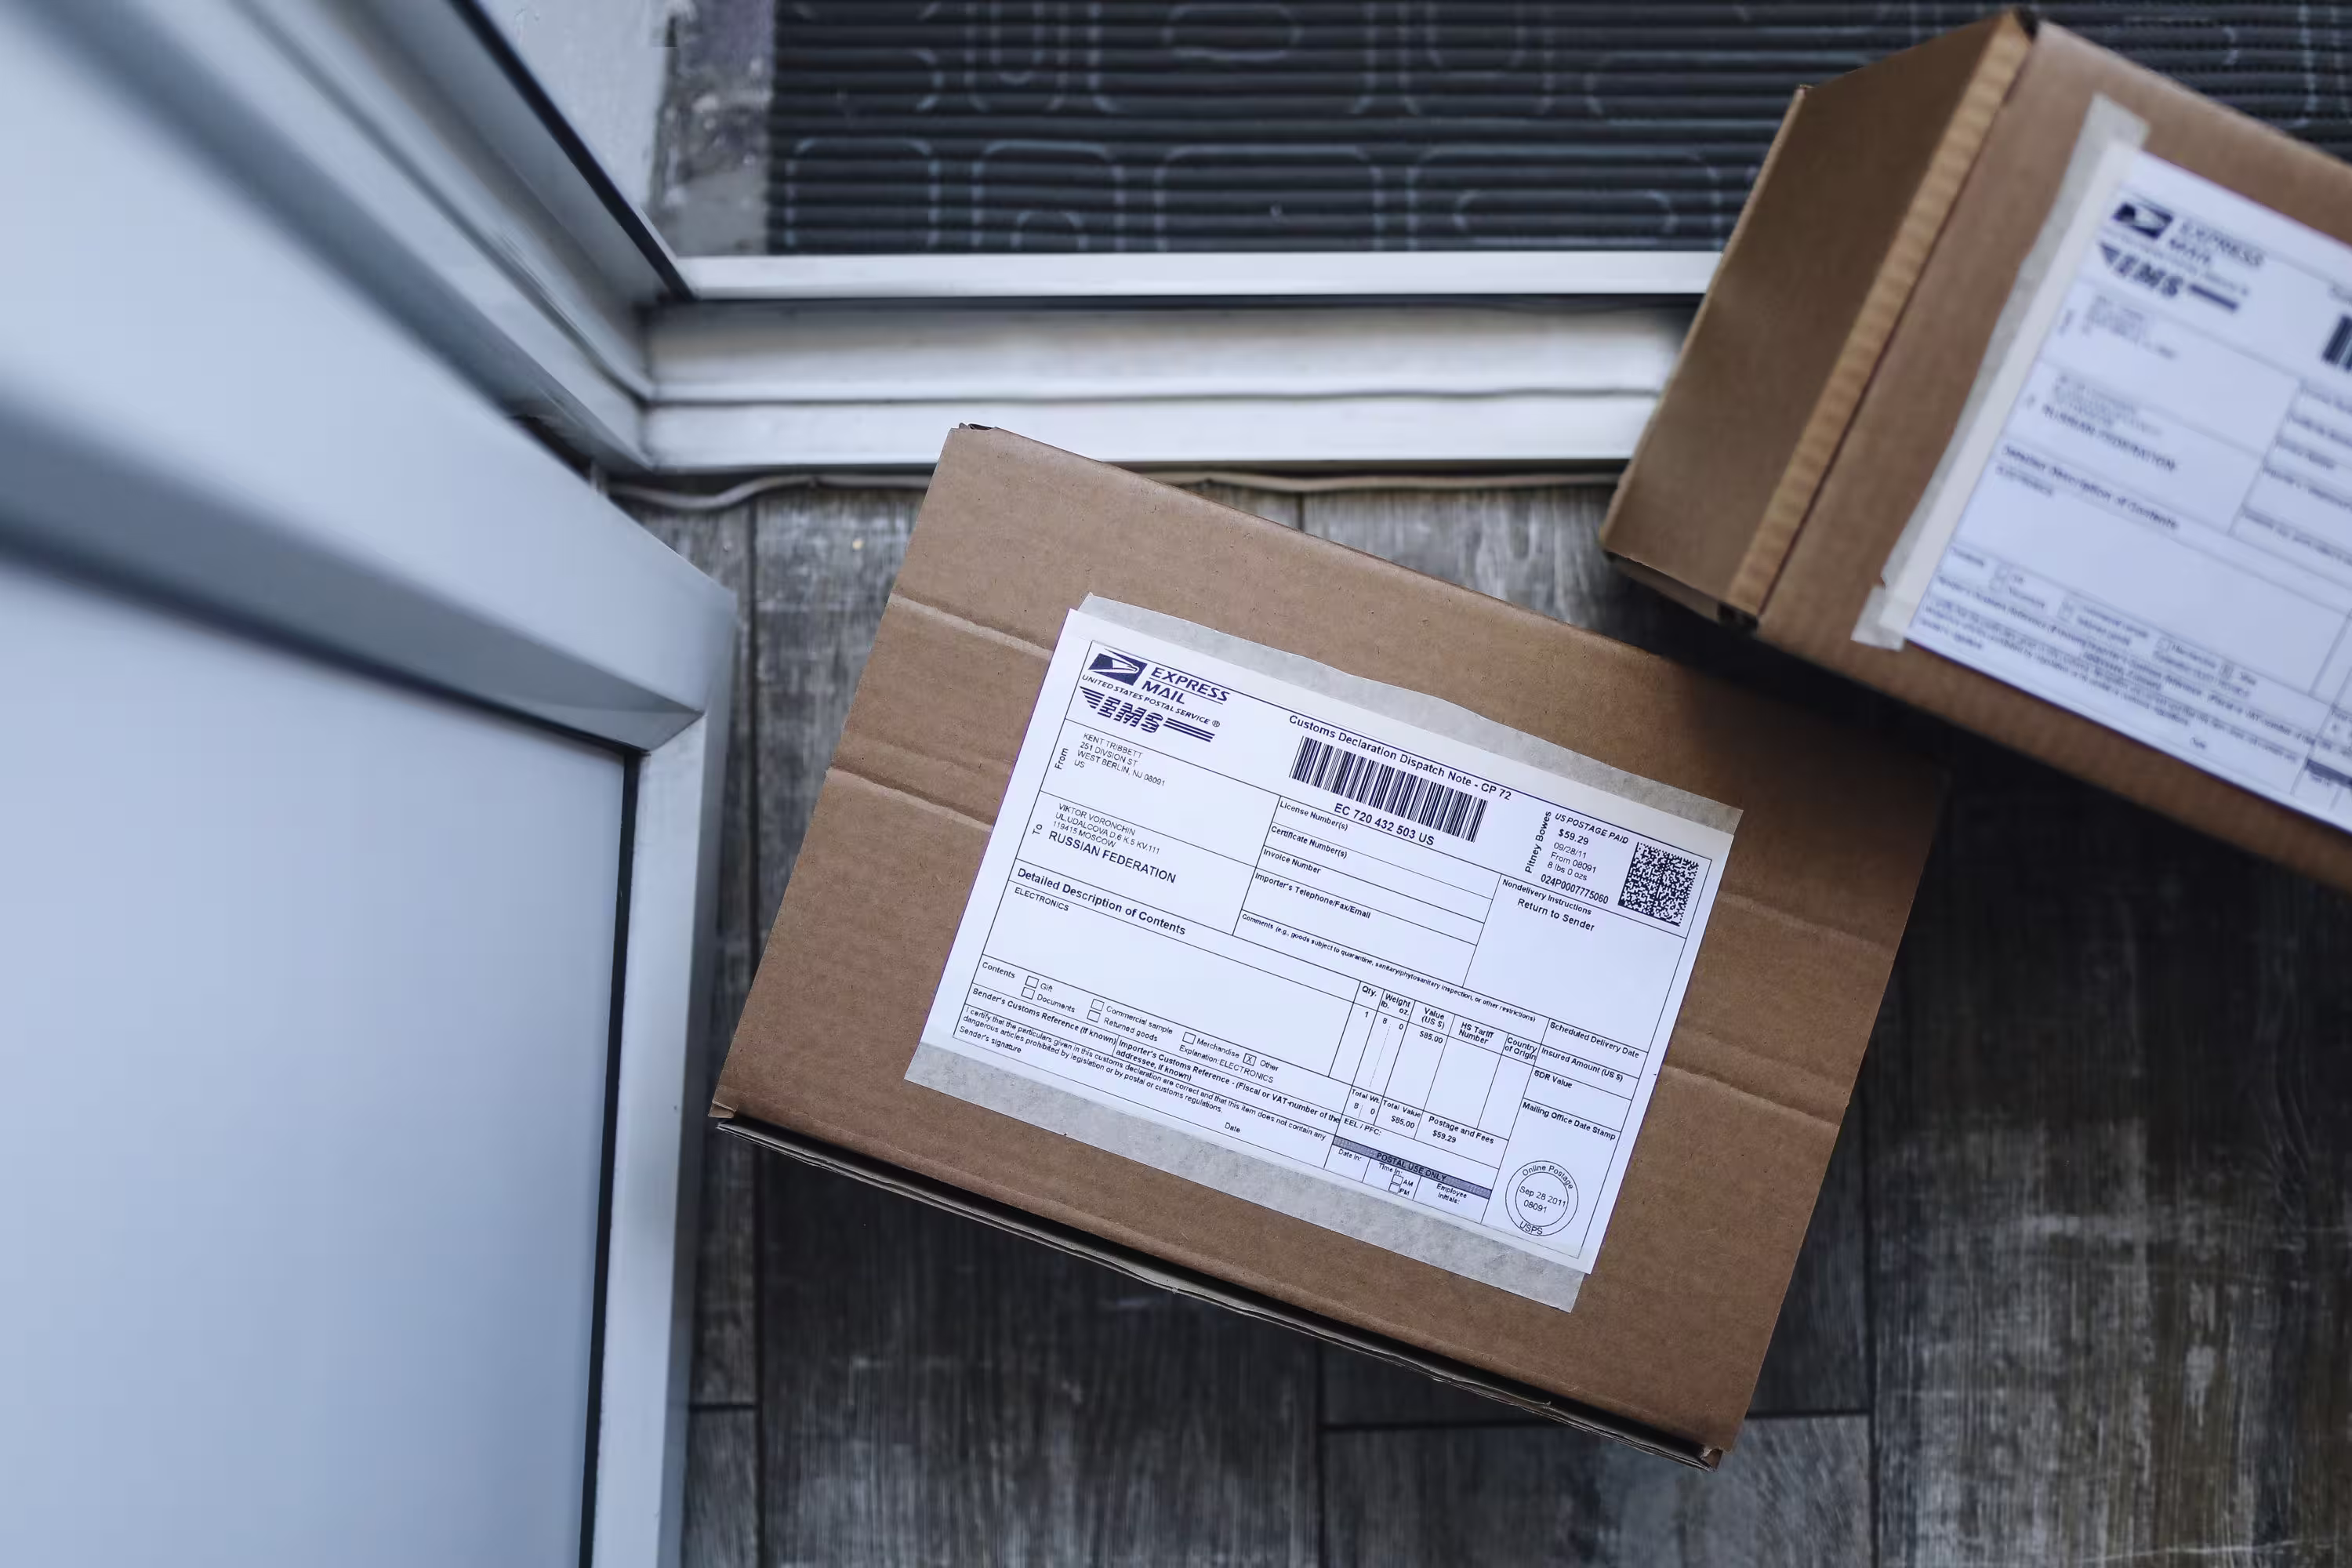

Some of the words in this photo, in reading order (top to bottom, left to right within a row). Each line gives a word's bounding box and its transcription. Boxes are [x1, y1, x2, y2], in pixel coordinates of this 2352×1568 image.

[1141, 680, 1185, 705] MAIL
[1150, 666, 1230, 702] EXPRESS
[1081, 673, 1114, 689] UNITED
[1113, 686, 1143, 700] STATES
[1143, 696, 1174, 712] POSTAL
[1174, 708, 1210, 724] SERVICE
[1096, 695, 1164, 734] EMS
[1079, 741, 1093, 751] 251
[1094, 746, 1127, 764] DIVSION
[1127, 757, 1138, 767] ST
[1083, 732, 1105, 745] KENT
[1106, 740, 1143, 758] TRIBBETT
[1289, 714, 1336, 739] Customs
[1338, 731, 1397, 760] Declaration
[1399, 753, 1445, 777] Dispatch
[1446, 770, 1472, 786] Note
[1480, 782, 1497, 794] CP
[1498, 788, 1512, 800] 72
[1054, 747, 1069, 770] From
[1073, 759, 1085, 768] US
[1077, 749, 1102, 763] WEST
[1101, 757, 1130, 775] BERLIN,
[1132, 769, 1143, 779] NJ
[1143, 773, 1165, 786] 08091
[1031, 823, 1043, 835] To
[1058, 803, 1087, 819] VIKTOR
[1088, 813, 1136, 836] VORONCHIN
[1279, 800, 1309, 817] License
[1309, 811, 1348, 832] Number(s)
[1334, 802, 1351, 816] EC
[1353, 808, 1373, 824] 720
[1374, 817, 1395, 832] 432
[1396, 824, 1416, 840] 503
[1418, 832, 1435, 846] US
[1555, 812, 1566, 822] US
[1566, 816, 1608, 837] POSTAGE
[1607, 831, 1629, 844] PAID
[1053, 820, 1078, 834] 119415
[1077, 829, 1116, 848] MOSCOW
[1270, 826, 1308, 844] Certificate
[1308, 838, 1348, 859] Number(s)
[1524, 843, 1542, 873] Pitney
[1534, 811, 1552, 842] Bowes
[1558, 828, 1589, 846] $59.29
[1048, 829, 1101, 857] RUSSIAN
[1102, 849, 1177, 884] FEDERATION
[1263, 848, 1290, 863] Invoice
[1291, 858, 1322, 874] Number
[1550, 851, 1571, 865] From
[1572, 858, 1596, 873] 08091
[1553, 841, 1587, 859] 09/28/11
[1554, 863, 1566, 873] lbs
[1573, 872, 1588, 881] ozs
[1014, 886, 1069, 912] ELECTRONICS
[1017, 867, 1061, 891] Detailed
[1061, 883, 1123, 913] Description
[1124, 908, 1138, 917] of
[1138, 910, 1186, 935] Contents
[1254, 872, 1293, 891] Importer's
[1294, 885, 1371, 919] Telephone/Fax/Email
[1501, 878, 1547, 901] Nondelivery
[1547, 894, 1592, 916] Instructions
[1540, 873, 1609, 905] 024P0007775060
[1517, 898, 1548, 916] Return
[1550, 909, 1560, 920] to
[1562, 913, 1595, 931] Sender
[982, 961, 1015, 978] Contents
[1241, 913, 1274, 930] Comments
[1275, 926, 1290, 937] (e.g.,
[1290, 932, 1310, 943] goods
[1310, 939, 1334, 951] subject
[1340, 949, 1374, 966] quarantine,
[1374, 962, 1441, 990] sanitary/phytosanitary
[1440, 984, 1473, 1001] inspection,
[1482, 1000, 1499, 1009] other
[1498, 1005, 1536, 1022] restrictions)
[1040, 982, 1053, 993] Gift
[1361, 985, 1377, 997] Qty.
[1385, 993, 1411, 1008] Weight
[1036, 993, 1076, 1013] Documents
[1380, 1000, 1389, 1009] lb.
[1399, 1007, 1410, 1016] oz.
[1424, 1007, 1445, 1020] Value
[972, 987, 1006, 1005] Sender's
[1007, 1000, 1040, 1018] Customs
[1040, 1011, 1080, 1032] Reference
[1080, 1025, 1089, 1034] (if
[1088, 1029, 1116, 1046] known)
[1103, 1016, 1136, 1034] Returned
[1135, 1029, 1158, 1042] goods
[1105, 1005, 1148, 1025] Commercial
[1148, 1022, 1173, 1035] sample
[1421, 1014, 1436, 1025] (US
[1436, 1020, 1445, 1030] $)
[959, 1025, 989, 1042] Sender's
[990, 1038, 1022, 1054] signature
[1418, 1030, 1443, 1044] $85.00
[1457, 1028, 1489, 1044] Number
[1460, 1021, 1472, 1031] HS
[1474, 1025, 1495, 1039] Tariff
[1549, 1021, 1590, 1041] Scheduled
[1590, 1035, 1621, 1053] Delivery
[1621, 1047, 1639, 1058] Date
[1196, 1037, 1240, 1058] Merchandise
[1506, 1036, 1538, 1054] Country
[1513, 1047, 1537, 1061] Origin
[1259, 1059, 1279, 1072] Other
[1541, 1047, 1571, 1063] Insured
[1570, 1058, 1601, 1073] Amount
[1600, 1068, 1615, 1079] (US
[1615, 1073, 1624, 1083] $)
[1534, 1069, 1551, 1081] SDR
[1552, 1075, 1573, 1089] Value
[1224, 1121, 1240, 1133] Date
[1428, 1115, 1459, 1132] Postage
[1460, 1127, 1475, 1138] and
[1475, 1131, 1494, 1145] Fees
[1522, 1101, 1550, 1118] Mailing
[1550, 1111, 1573, 1125] Office
[1573, 1119, 1591, 1131] Date
[1592, 1126, 1616, 1142] Stamp
[1432, 1129, 1457, 1143] $59.29
[1375, 1152, 1407, 1169] POSTAL
[1407, 1163, 1425, 1175] USE
[1424, 1169, 1447, 1182] ONLY
[1522, 1164, 1545, 1176] Online
[1548, 1165, 1573, 1189] Postage
[1519, 1185, 1535, 1198] Sep
[1535, 1191, 1547, 1201] 28
[1547, 1195, 1566, 1207] 2011
[1523, 1199, 1548, 1214] 08091
[1519, 1221, 1542, 1234] USPS
